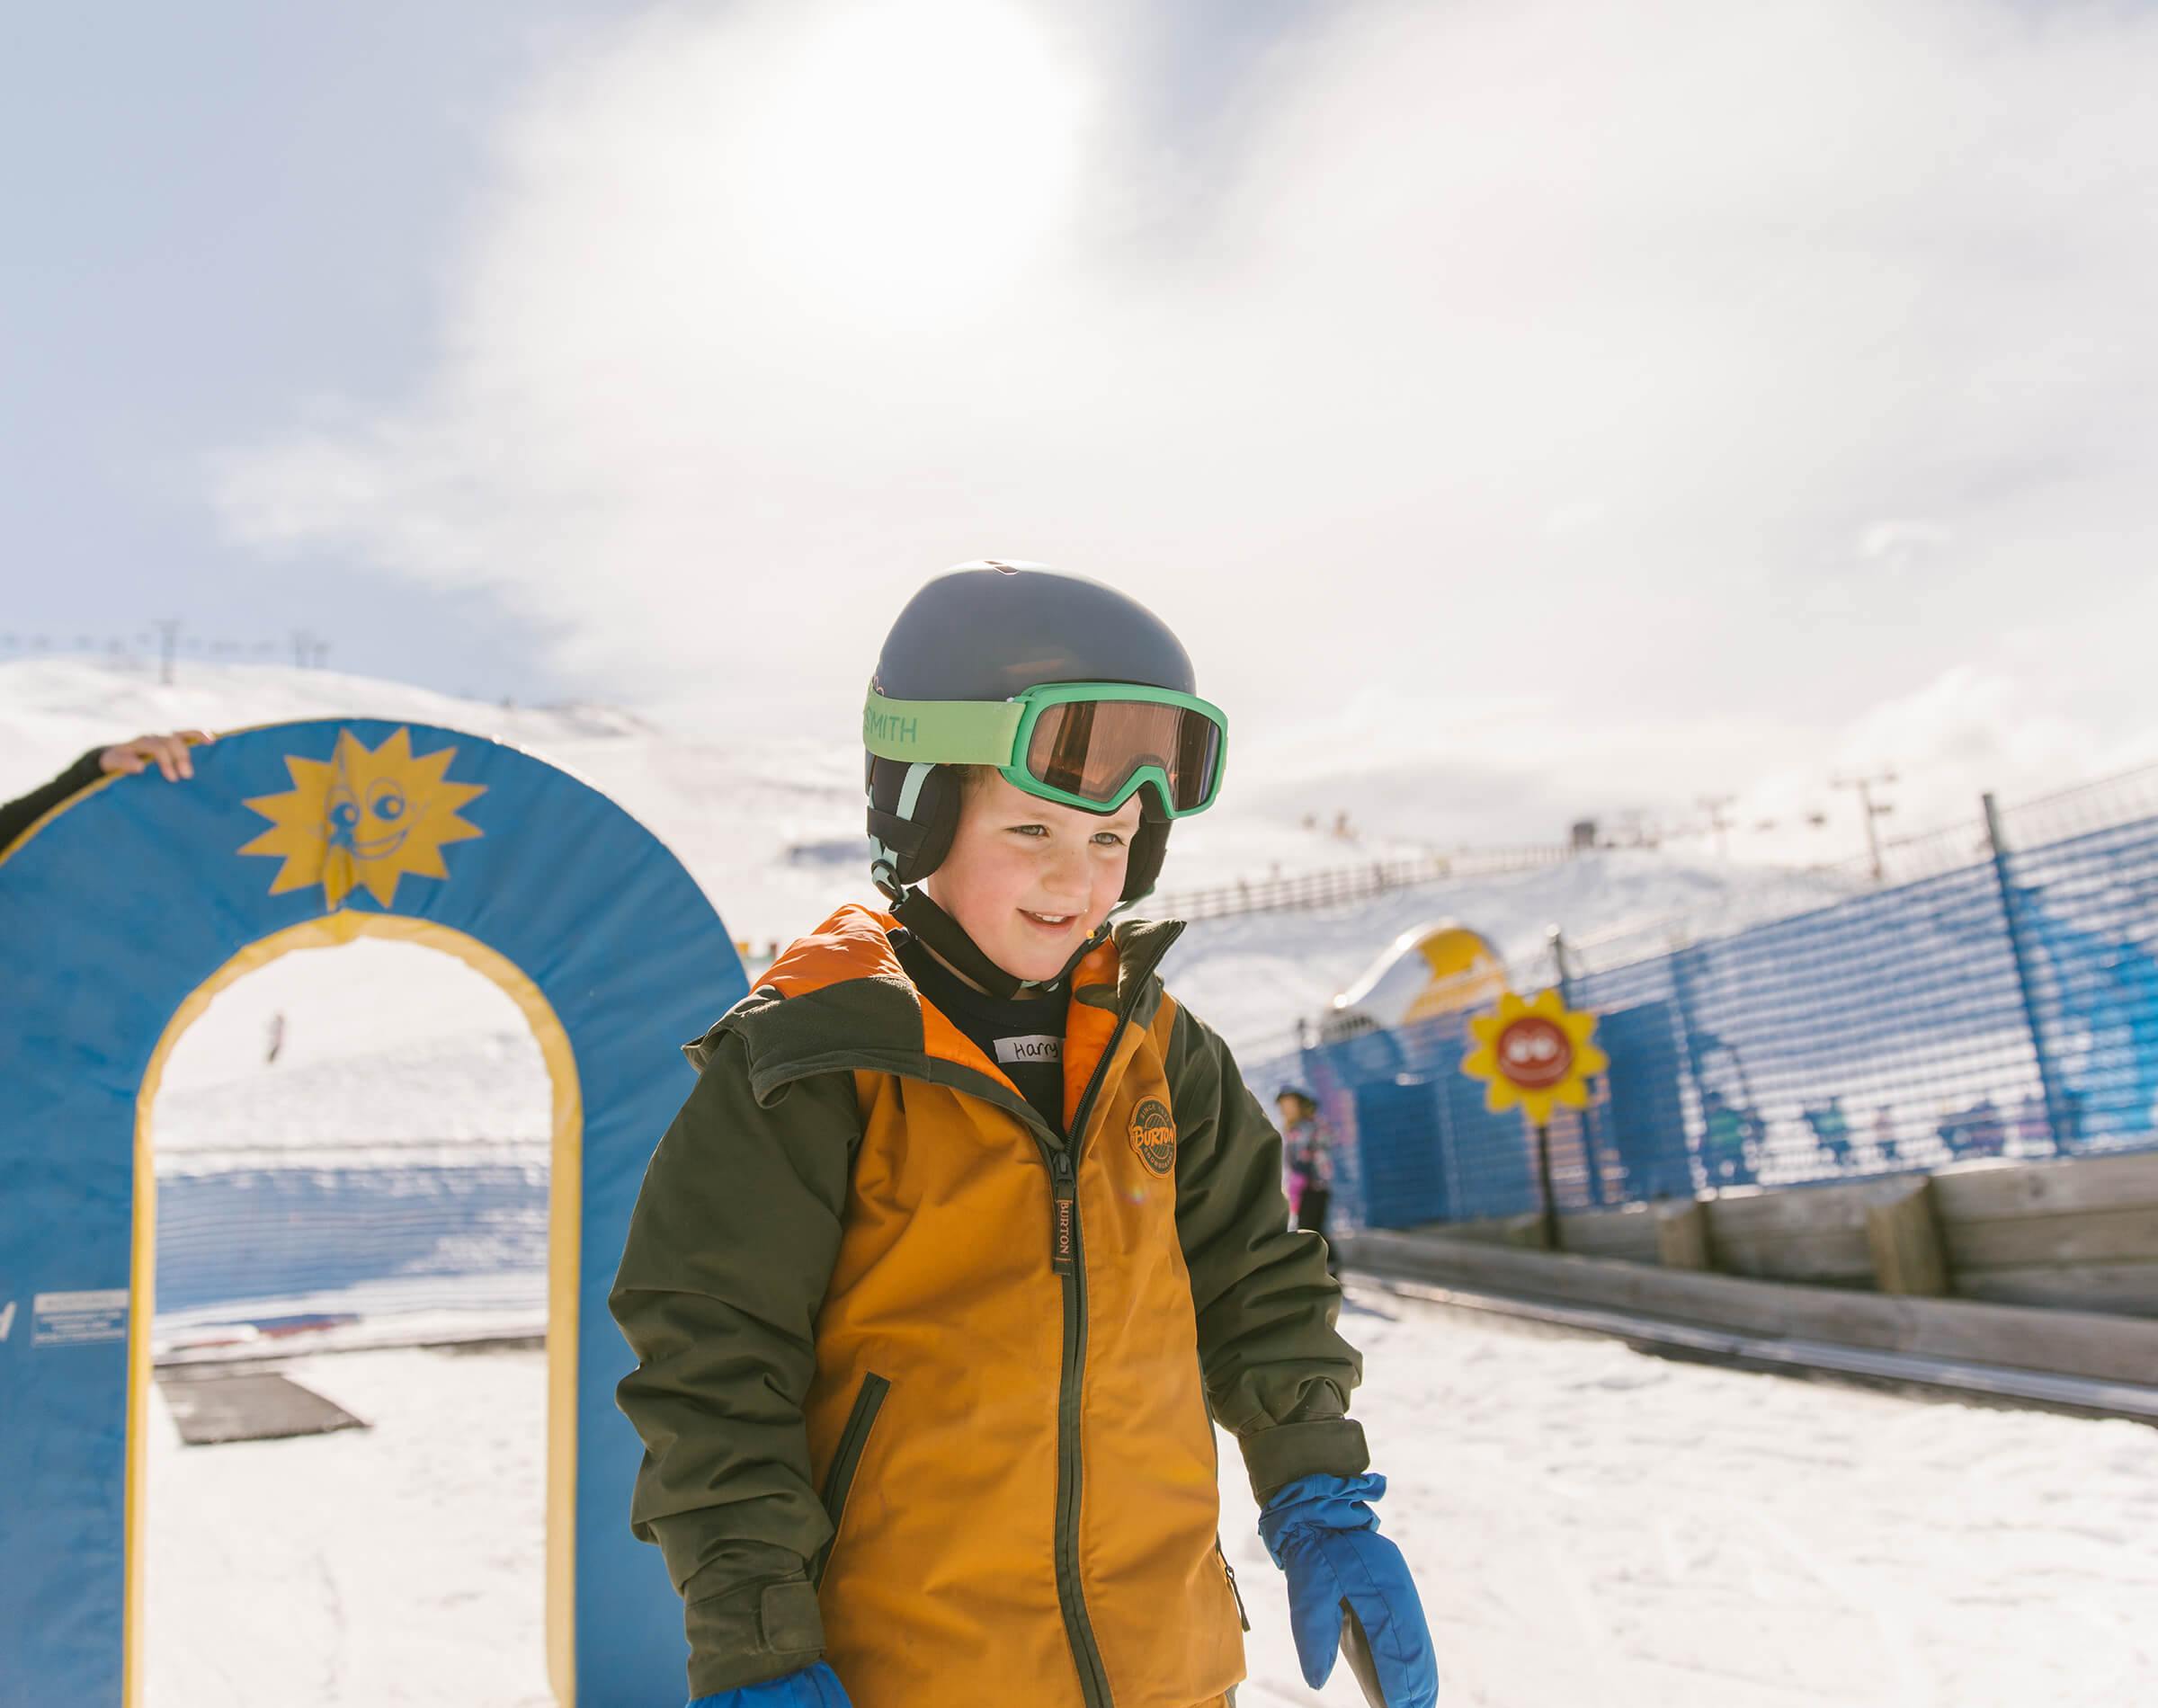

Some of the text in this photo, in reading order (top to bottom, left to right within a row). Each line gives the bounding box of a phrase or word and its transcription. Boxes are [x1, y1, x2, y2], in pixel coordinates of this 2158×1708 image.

[864, 707, 918, 743] SMITH
[1013, 1042, 1058, 1060] Harry
[1133, 1125, 1173, 1148] BURTON
[1059, 1201, 1070, 1255] BURTON
